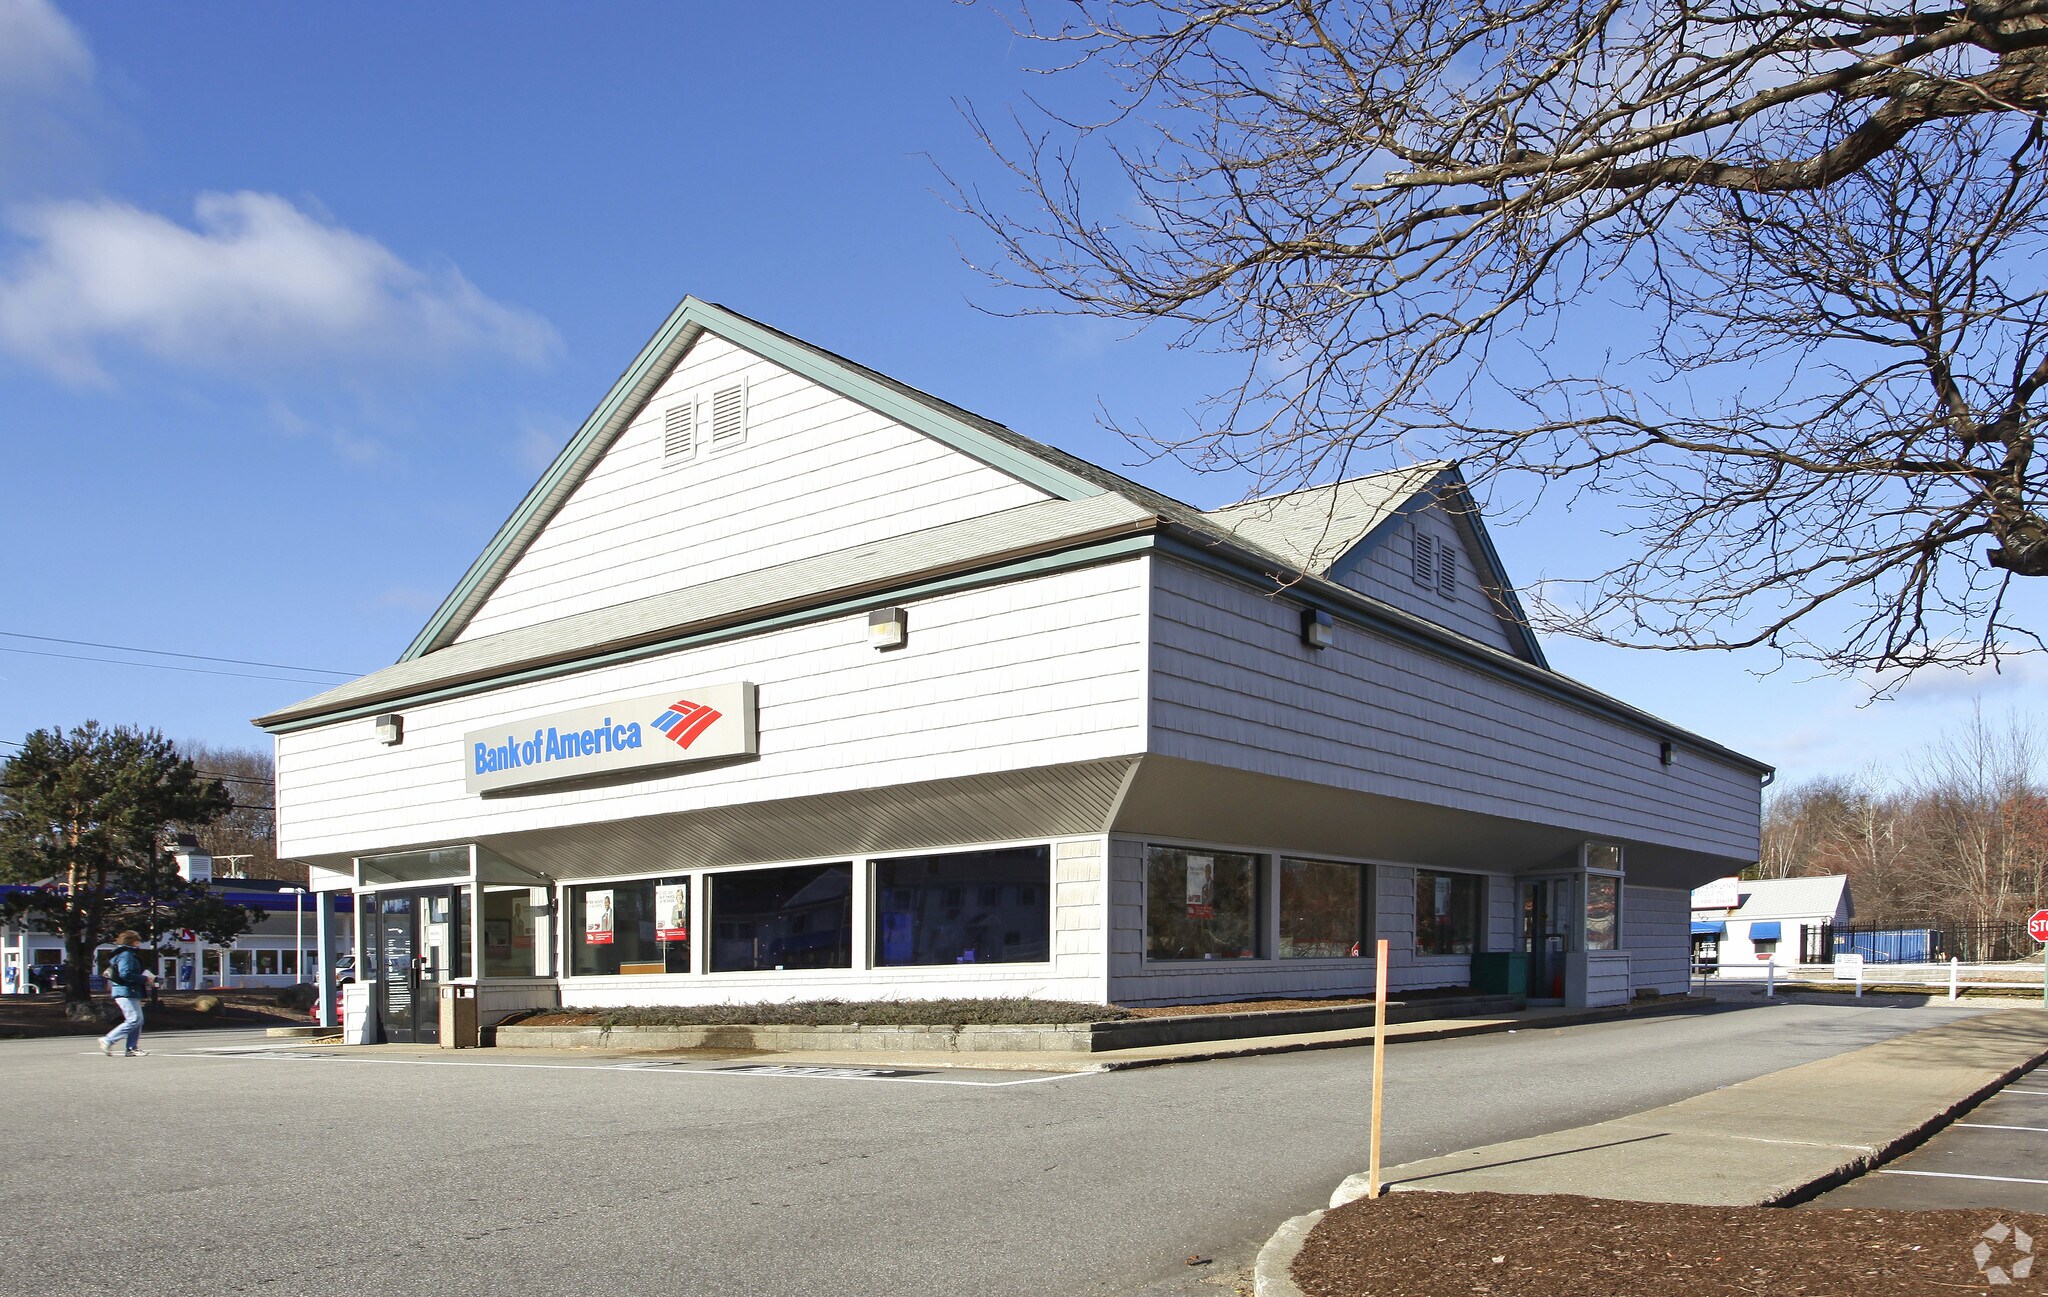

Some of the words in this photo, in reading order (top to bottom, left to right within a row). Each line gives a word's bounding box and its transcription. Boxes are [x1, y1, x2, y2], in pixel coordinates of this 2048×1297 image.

[475, 736, 521, 775] Bank
[522, 729, 543, 766] of
[545, 717, 642, 762] America
[2030, 920, 2048, 932] ST
